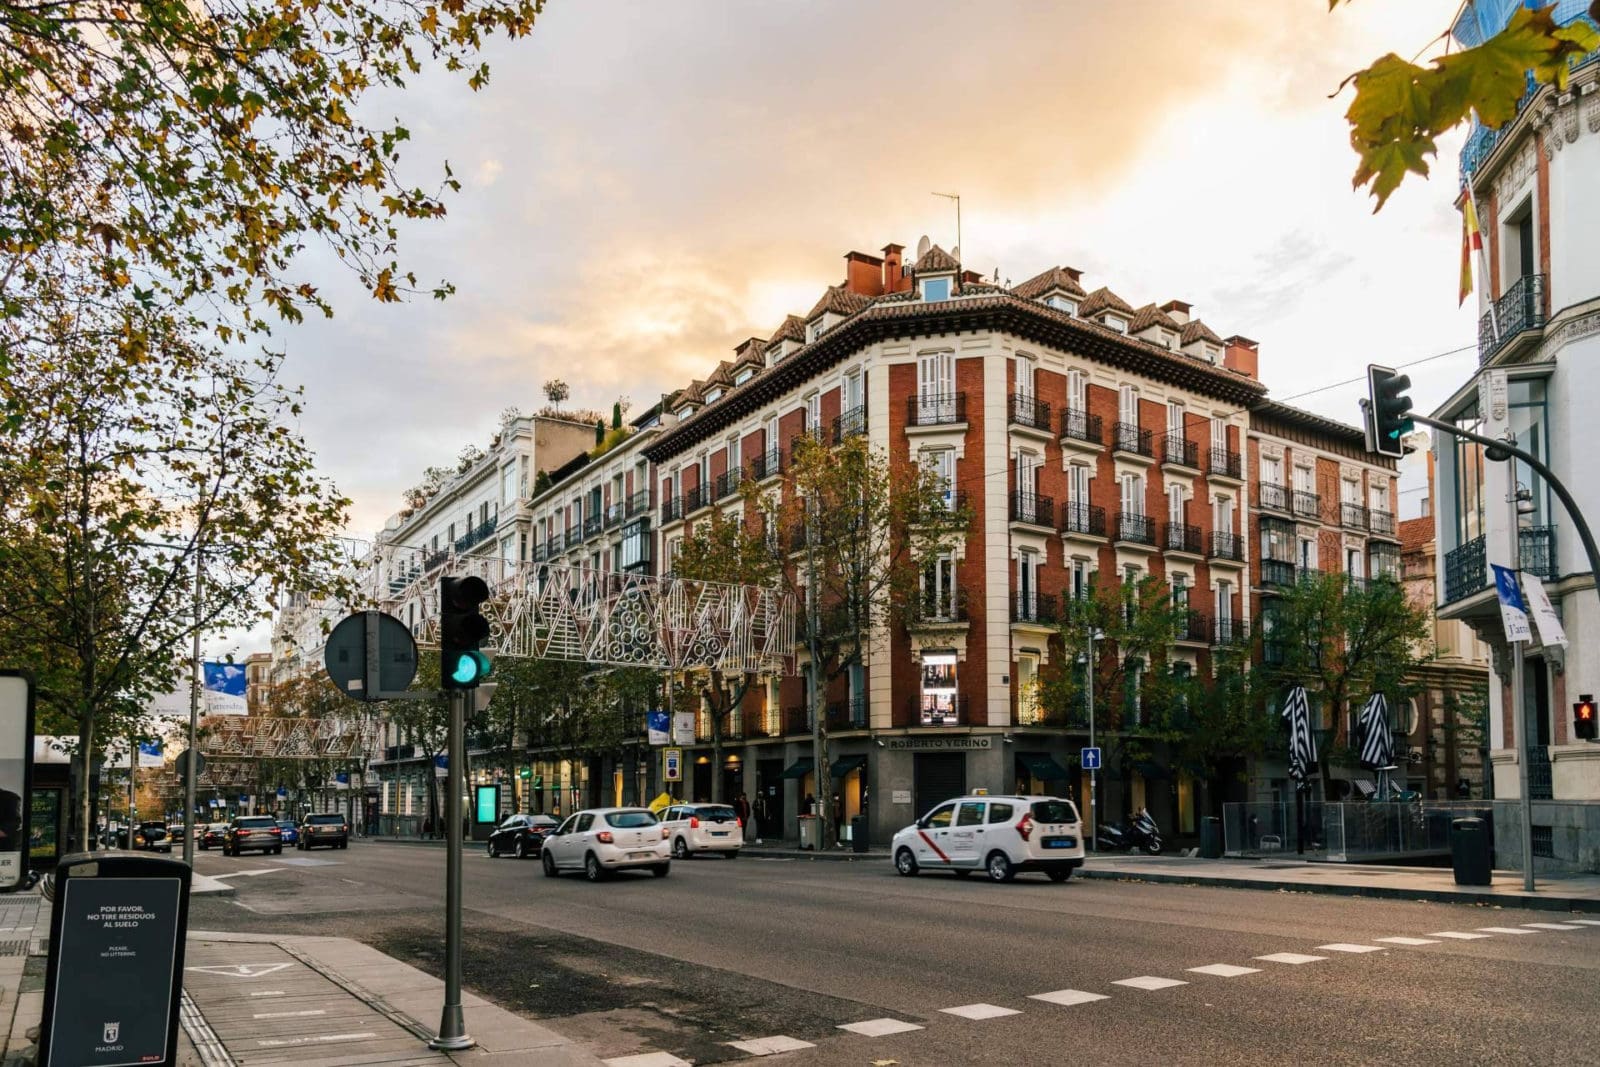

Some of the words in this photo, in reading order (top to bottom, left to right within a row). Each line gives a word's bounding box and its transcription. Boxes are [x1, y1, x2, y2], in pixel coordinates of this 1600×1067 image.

[891, 740, 942, 748] ROBERTO
[946, 739, 988, 747] VERINO
[100, 905, 117, 913] POR
[101, 913, 118, 921] TIRE
[118, 912, 156, 921] RESIDUOS
[114, 920, 139, 928] SUELO
[95, 1045, 125, 1053] MADRID
